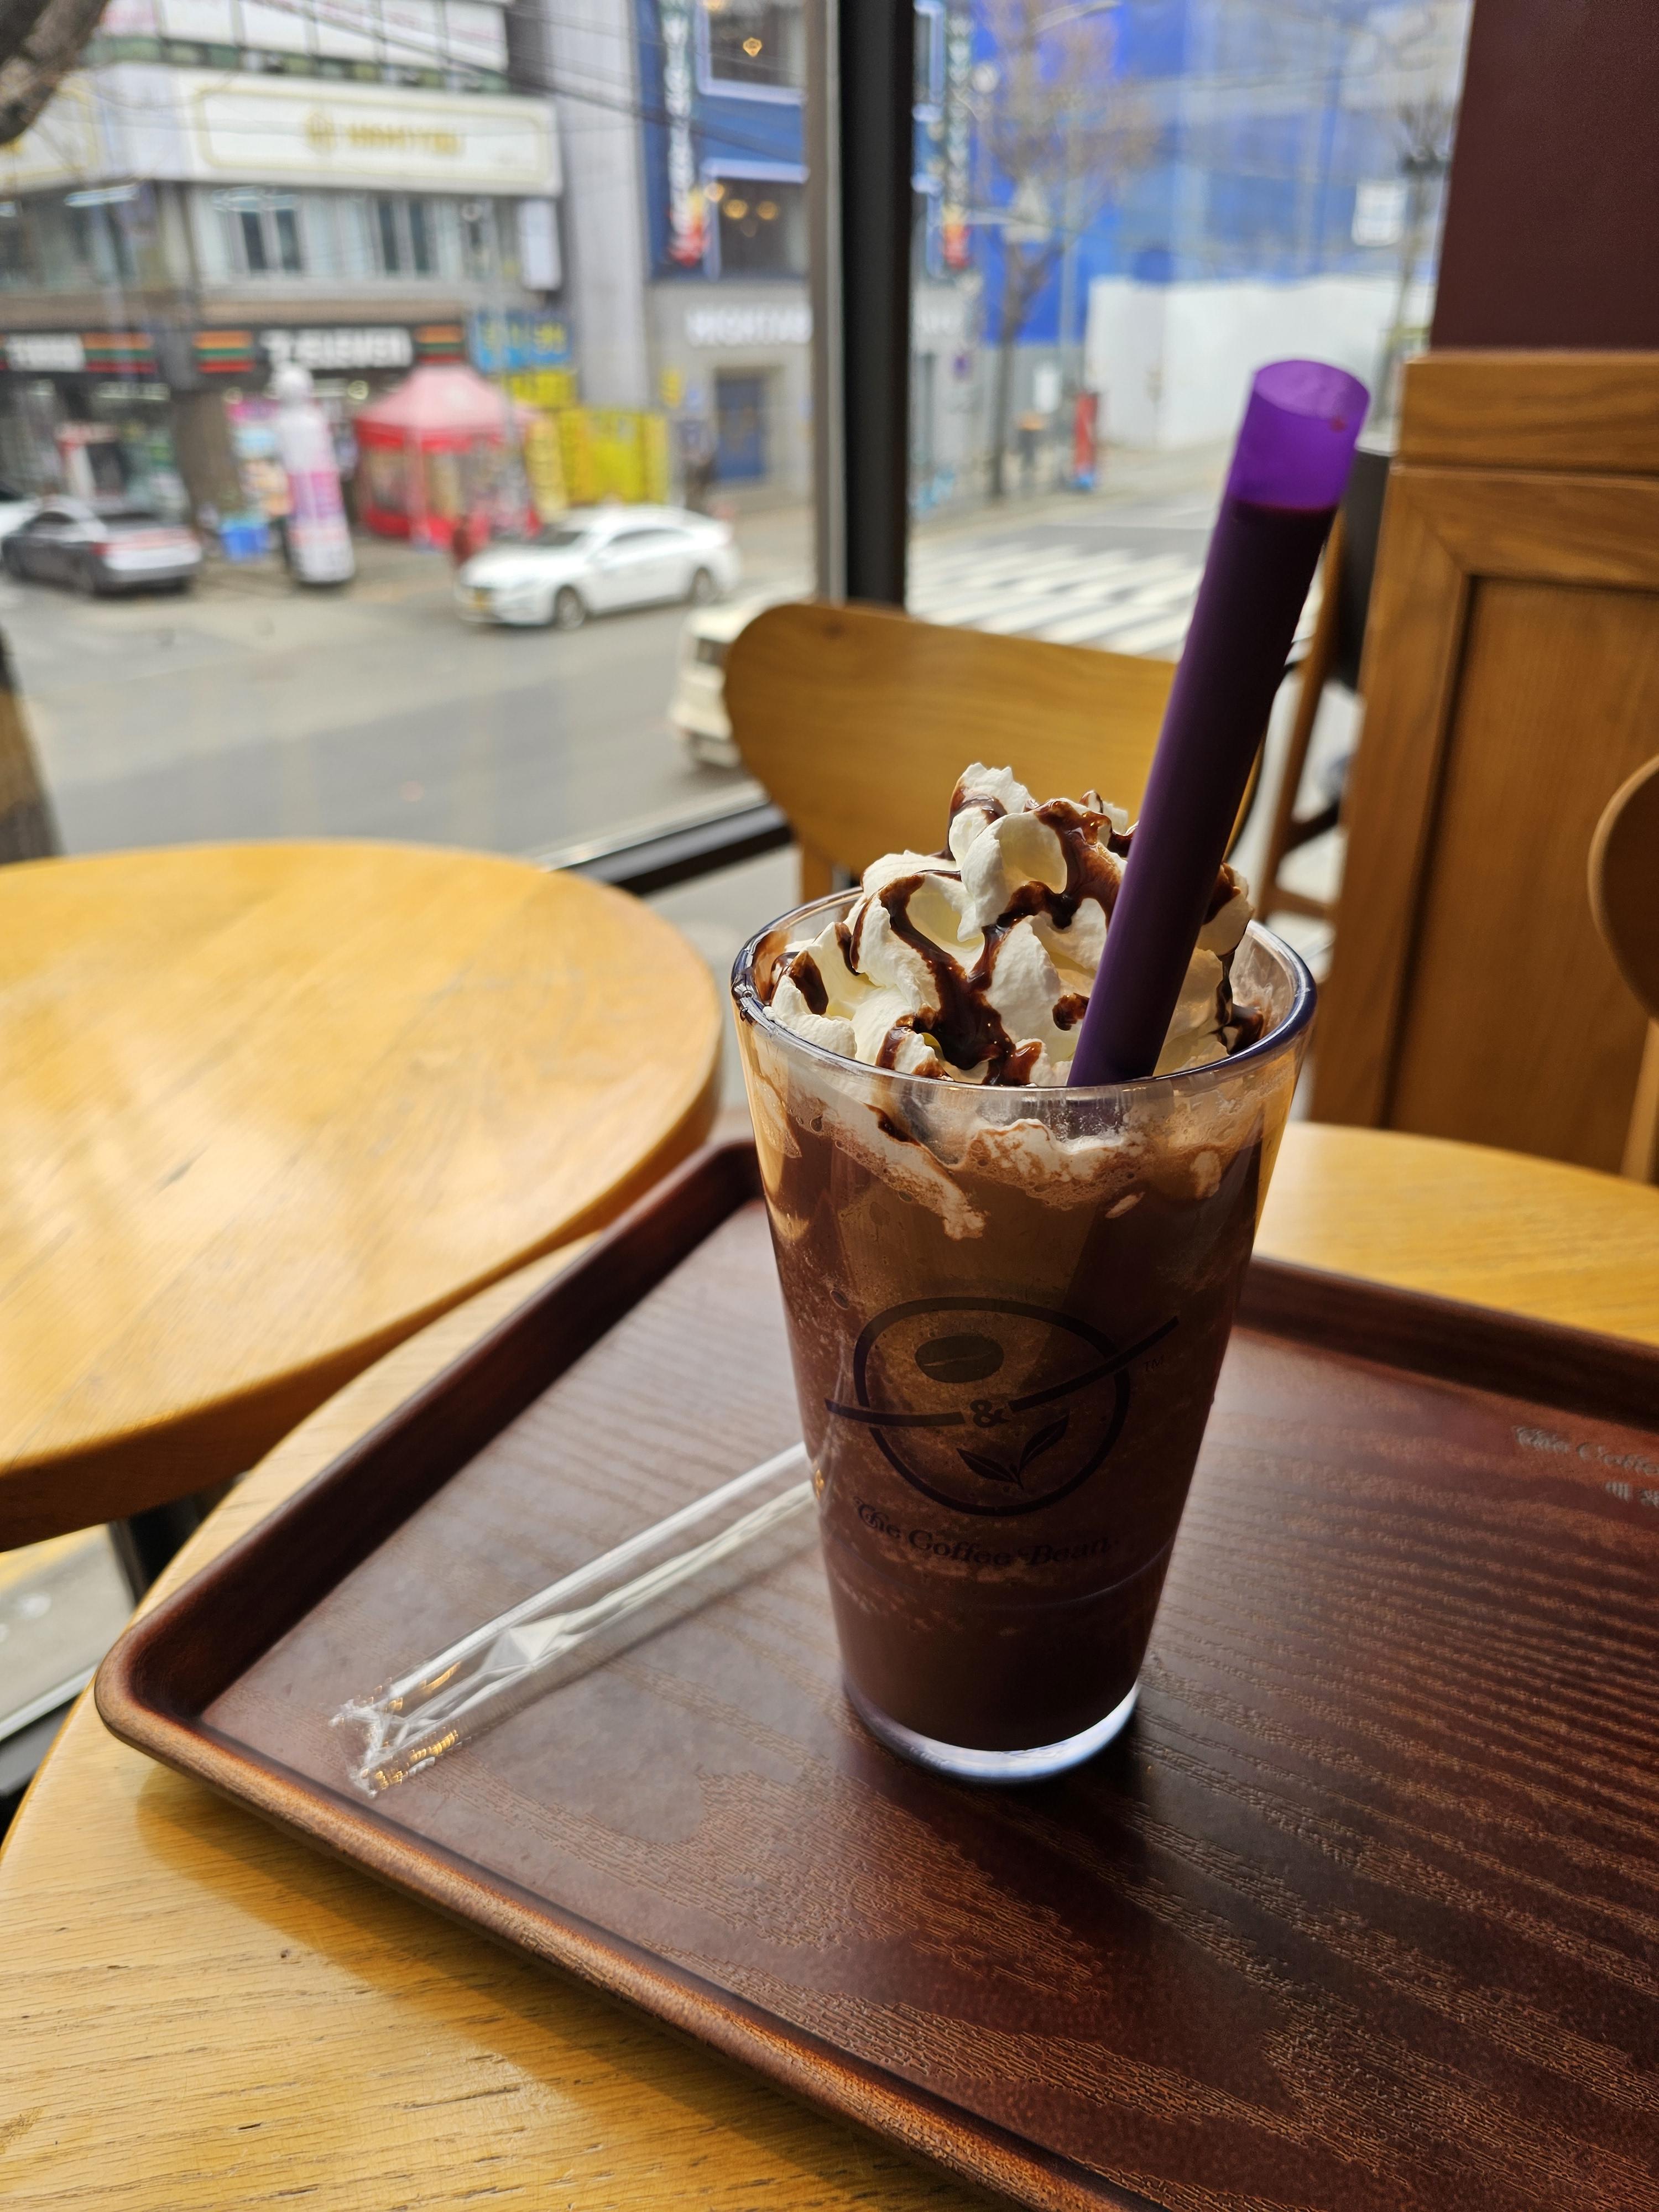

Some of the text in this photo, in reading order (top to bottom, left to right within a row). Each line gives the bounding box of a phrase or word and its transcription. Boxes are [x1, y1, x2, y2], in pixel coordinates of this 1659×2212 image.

[969, 1399, 1010, 1428] &
[852, 1495, 1113, 1567] The Coffee Bean
